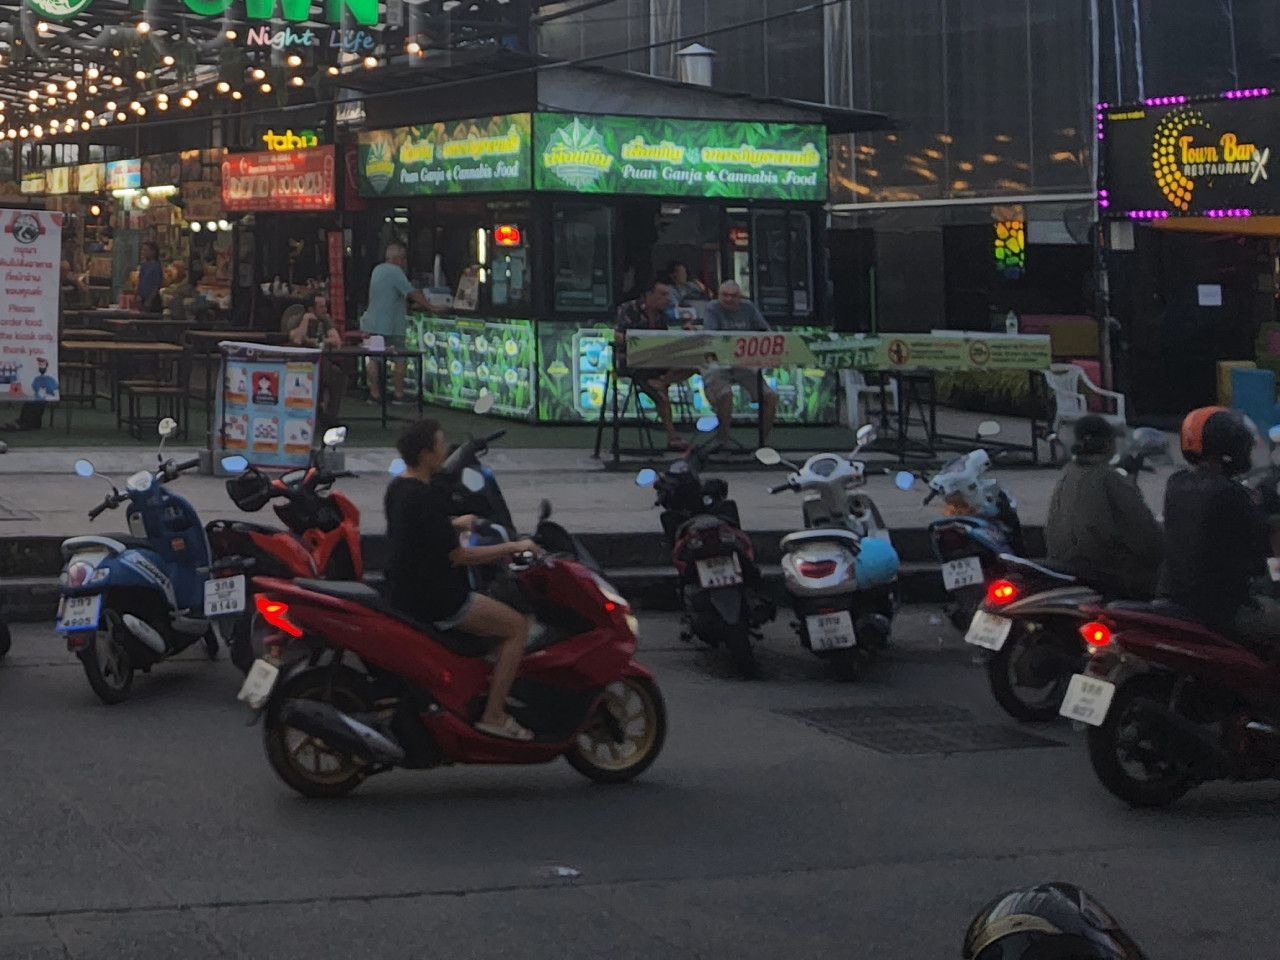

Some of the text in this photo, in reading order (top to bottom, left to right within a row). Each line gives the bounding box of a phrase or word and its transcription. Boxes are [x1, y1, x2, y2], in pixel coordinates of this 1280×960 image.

[246, 26, 375, 52] Night Life
[1178, 132, 1256, 164] Town Bar
[453, 163, 492, 180] Cannabis
[494, 160, 520, 178] Food
[622, 164, 818, 186] Puan Ganja Cannabis Food
[1183, 161, 1258, 176] RESTAURANT
[9, 304, 34, 313] Please
[0, 318, 43, 327] order food
